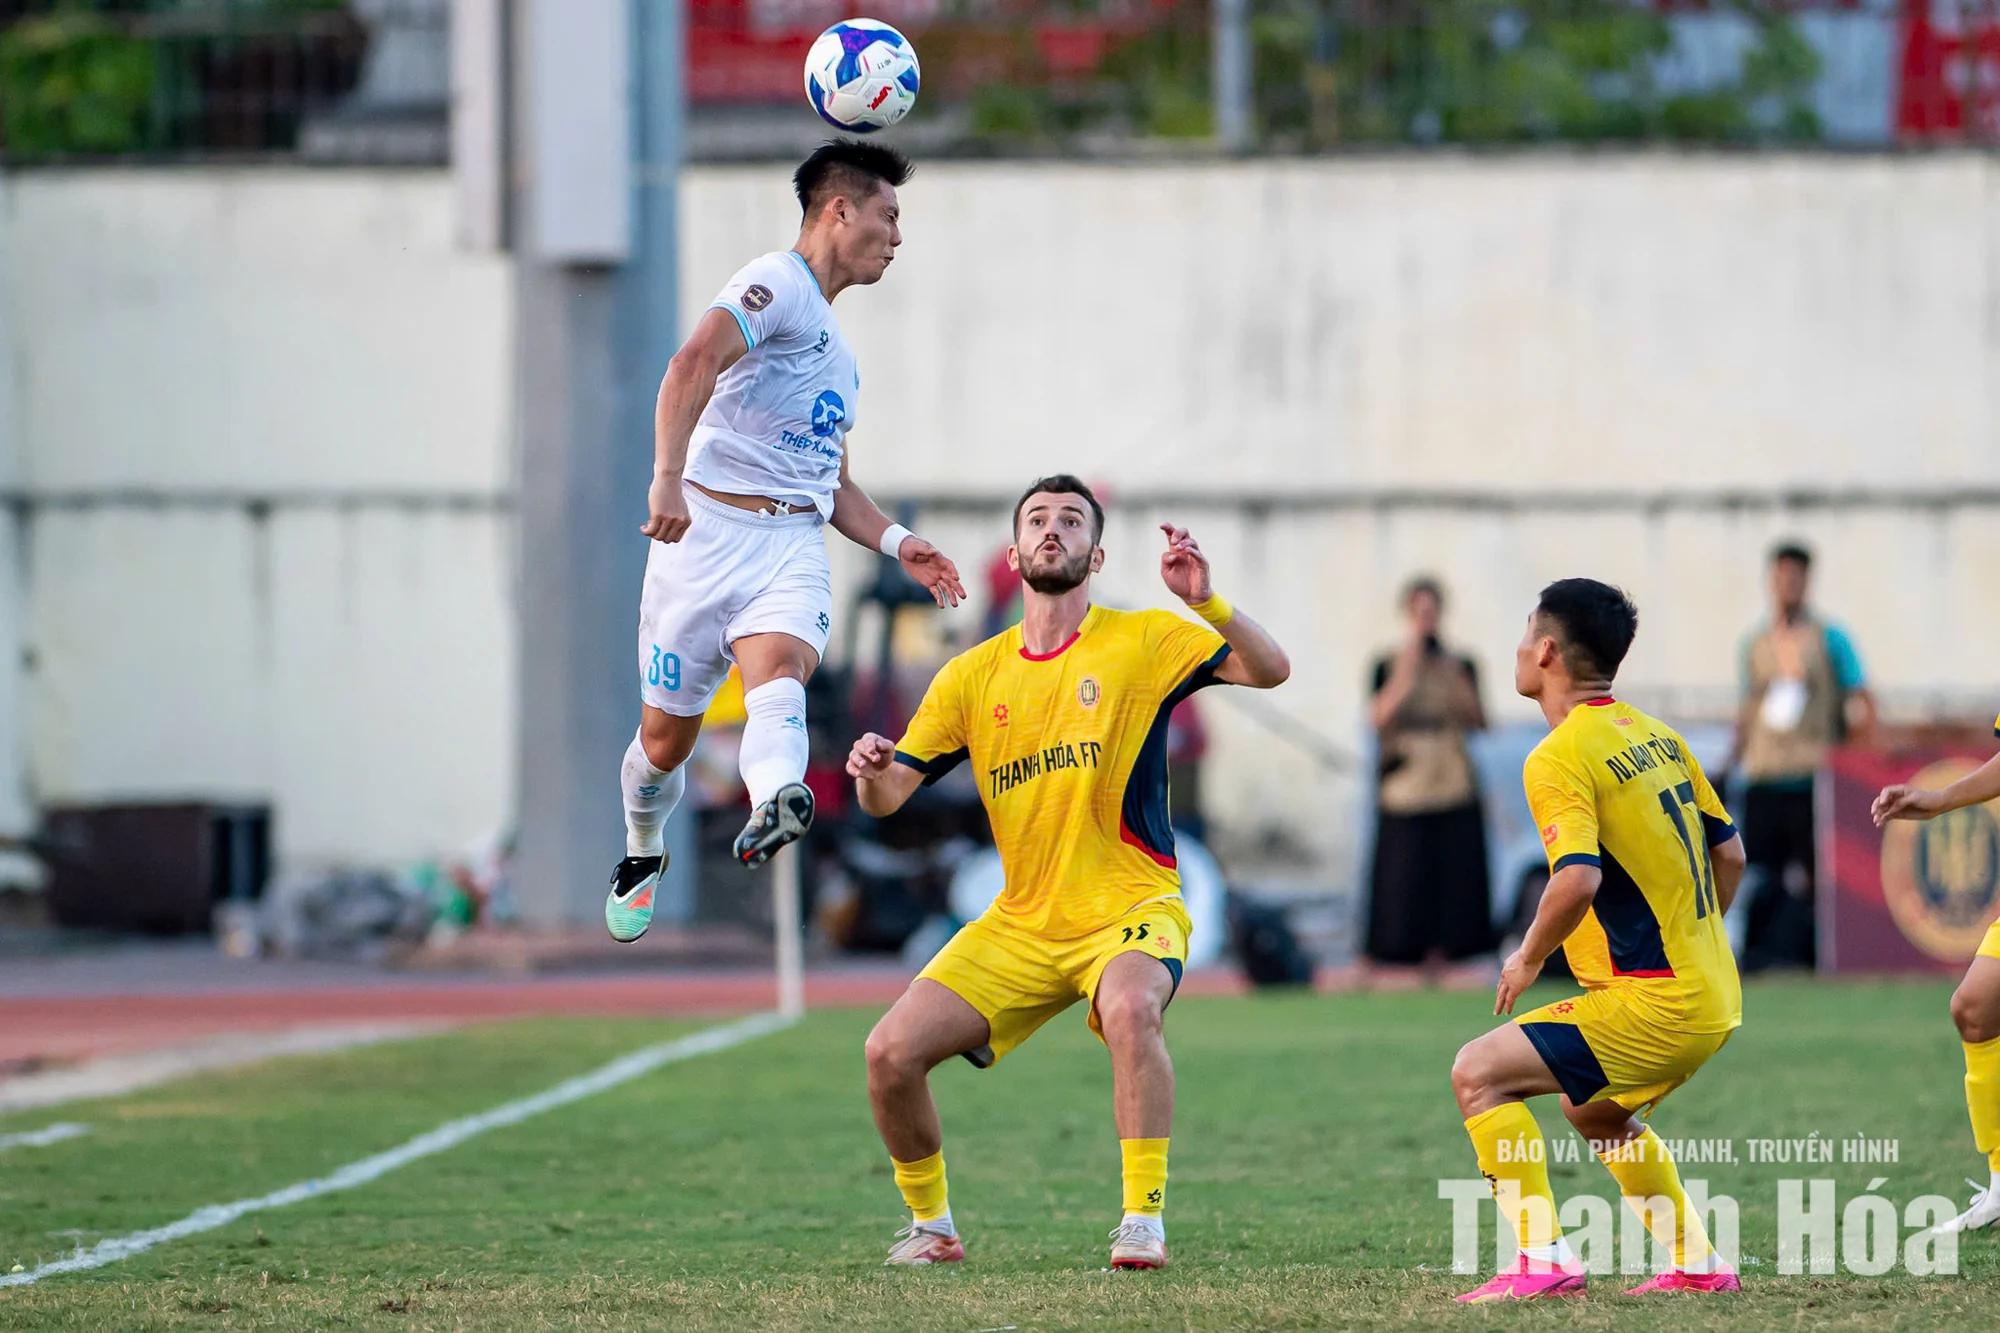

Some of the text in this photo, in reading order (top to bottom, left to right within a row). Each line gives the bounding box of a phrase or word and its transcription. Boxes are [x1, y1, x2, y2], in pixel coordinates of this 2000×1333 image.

[648, 643, 681, 692] 39
[989, 752, 1041, 799] THANH
[1042, 740, 1079, 772] HÓA
[1658, 780, 1715, 921] 17
